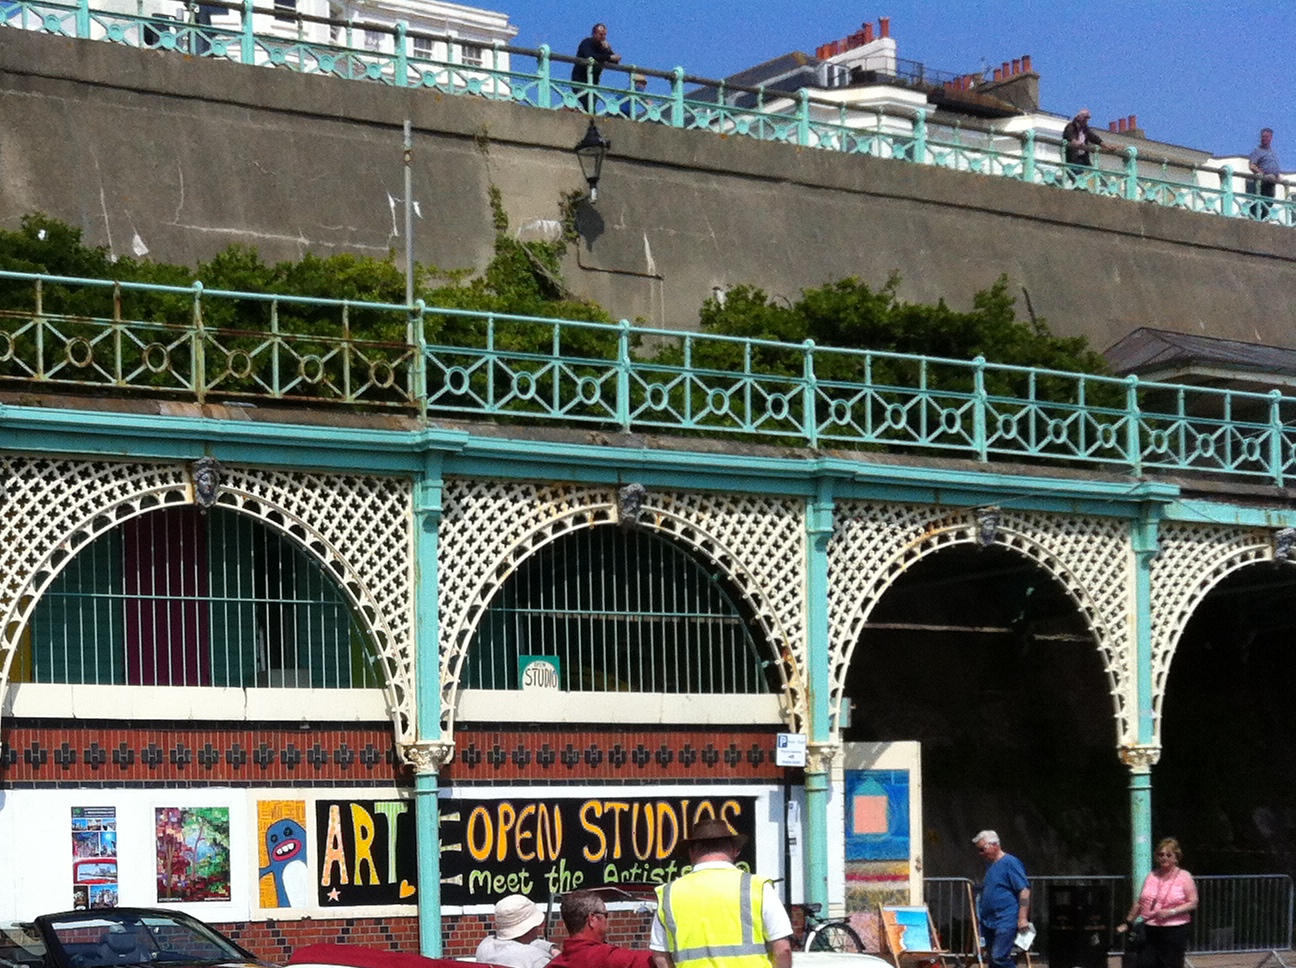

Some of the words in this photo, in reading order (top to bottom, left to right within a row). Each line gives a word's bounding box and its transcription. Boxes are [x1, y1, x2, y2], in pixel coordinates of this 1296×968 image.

[524, 668, 557, 688] STUDIO
[321, 801, 408, 886] ART
[467, 801, 562, 862] OPEN
[544, 858, 584, 893] the
